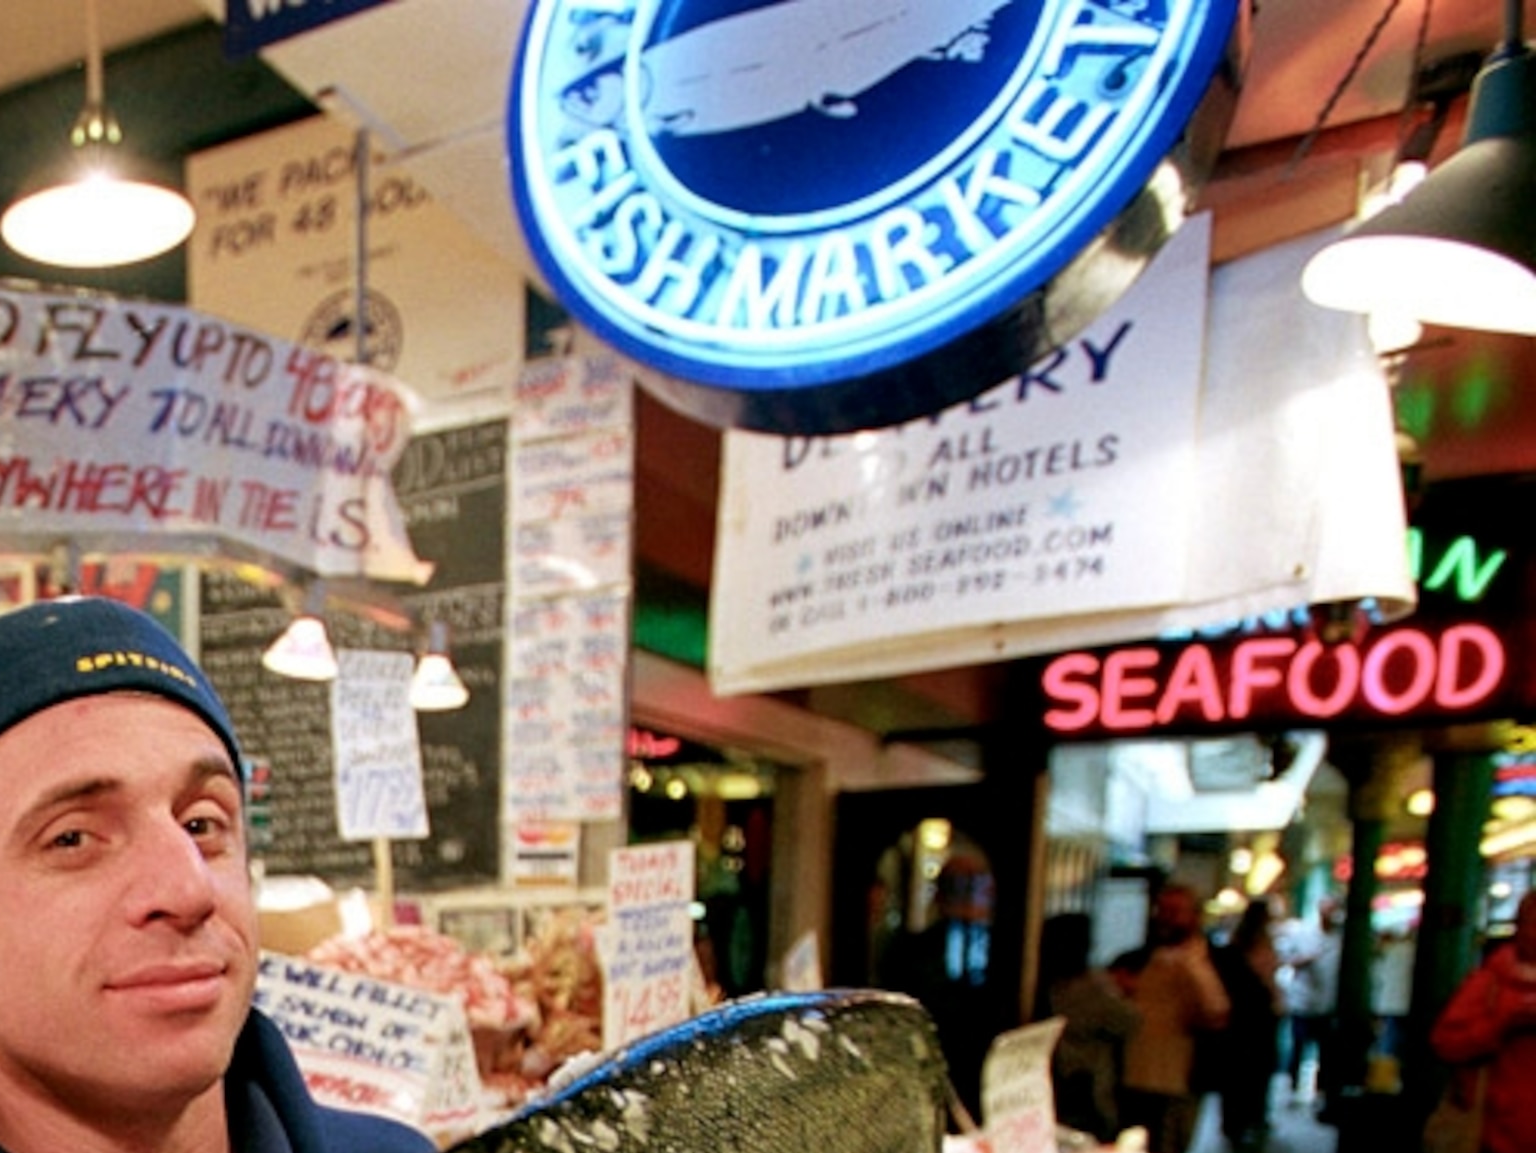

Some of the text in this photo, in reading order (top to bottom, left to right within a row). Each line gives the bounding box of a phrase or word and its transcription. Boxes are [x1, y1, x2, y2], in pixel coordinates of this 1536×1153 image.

[553, 0, 1161, 331] FISH MARKET
[291, 198, 335, 237] 48
[36, 301, 168, 371] FLY
[283, 346, 337, 424] 48
[149, 386, 210, 435] TO
[929, 425, 998, 471] ALL
[969, 433, 1123, 493] HOTELS
[933, 506, 1030, 545] ONLINE
[1041, 622, 1507, 732] SEAFOOD
[284, 964, 342, 995] WILL
[352, 982, 442, 1021] FILLET
